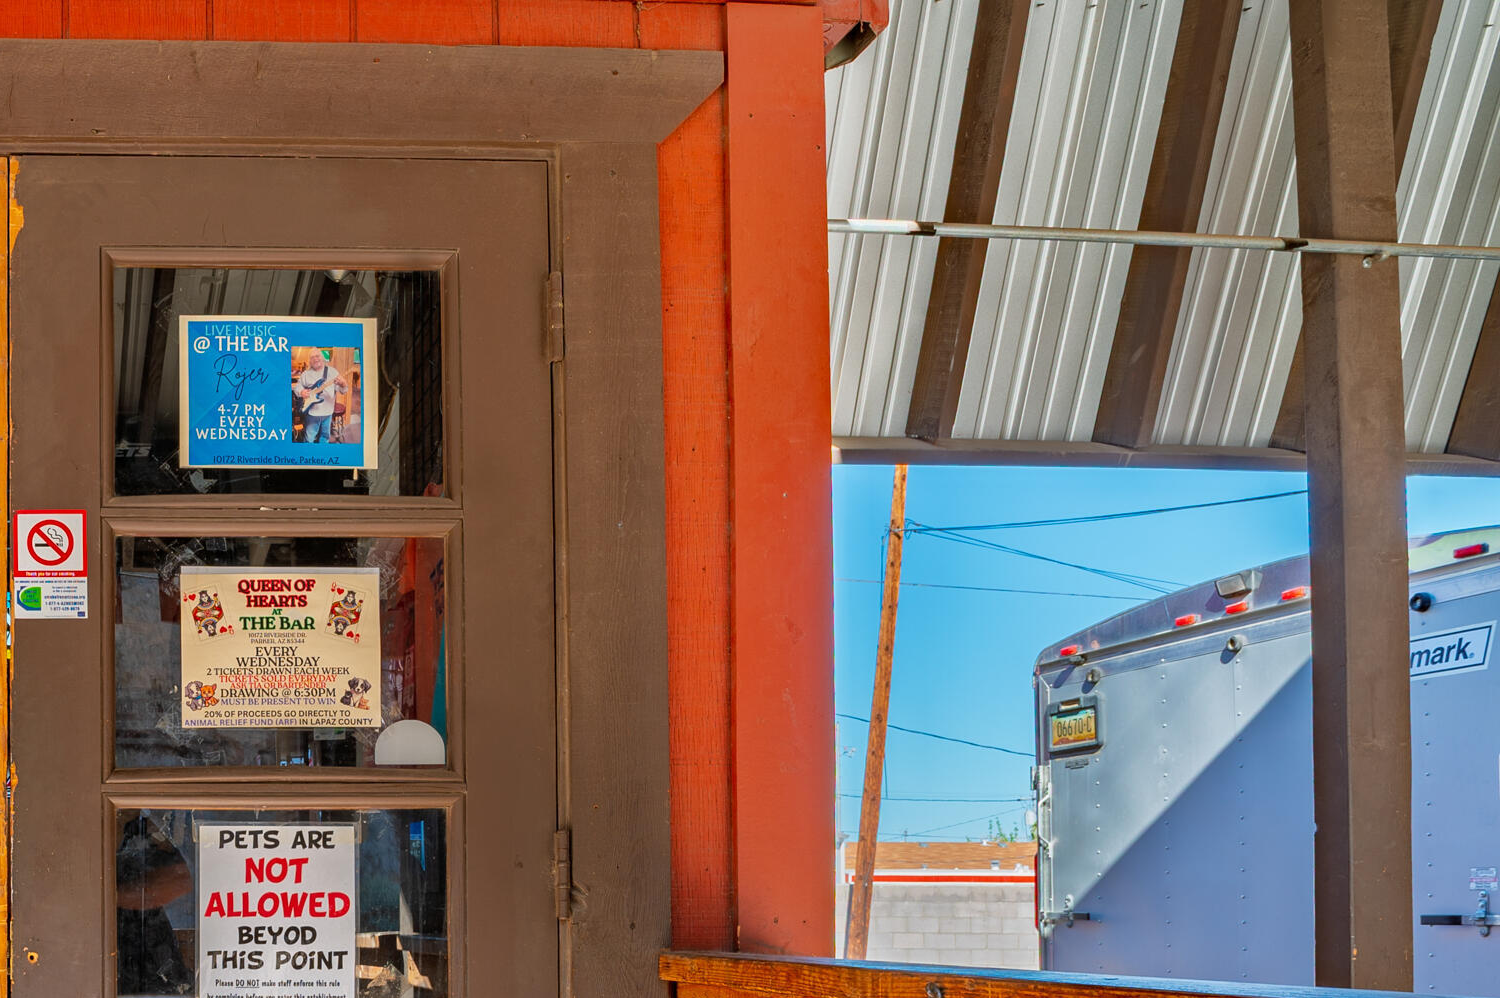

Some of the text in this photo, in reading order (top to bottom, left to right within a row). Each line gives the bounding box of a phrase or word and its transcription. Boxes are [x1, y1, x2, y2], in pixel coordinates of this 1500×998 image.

[205, 325, 277, 336] LIVE MUSIC
[193, 336, 289, 353] @ THE BAR
[217, 404, 266, 415] 4-7 PM
[219, 416, 264, 427] EVERY
[196, 428, 288, 441] WEDNESDAY
[213, 456, 340, 465] 10172 Riverside Drive, Parker, AZ
[238, 579, 316, 594] QUEEN OF
[246, 595, 308, 608] HEARTS
[239, 616, 316, 630] THE BAR
[255, 646, 298, 657] EVERY
[235, 656, 321, 667] WEDNESDAY
[219, 675, 337, 683] TICKETS SOLD EVERYDAY
[220, 688, 336, 697] DRAWING @ 6:30PM
[204, 710, 350, 718] 20% OF PROCEEDS GO DIRECTLY TO
[219, 830, 335, 849] PETS ARE
[245, 857, 309, 884] NOT
[204, 892, 351, 918] ALLOWED
[237, 925, 317, 945] BEYOD
[215, 979, 340, 987] Please DO NOT make staff enforce this rule
